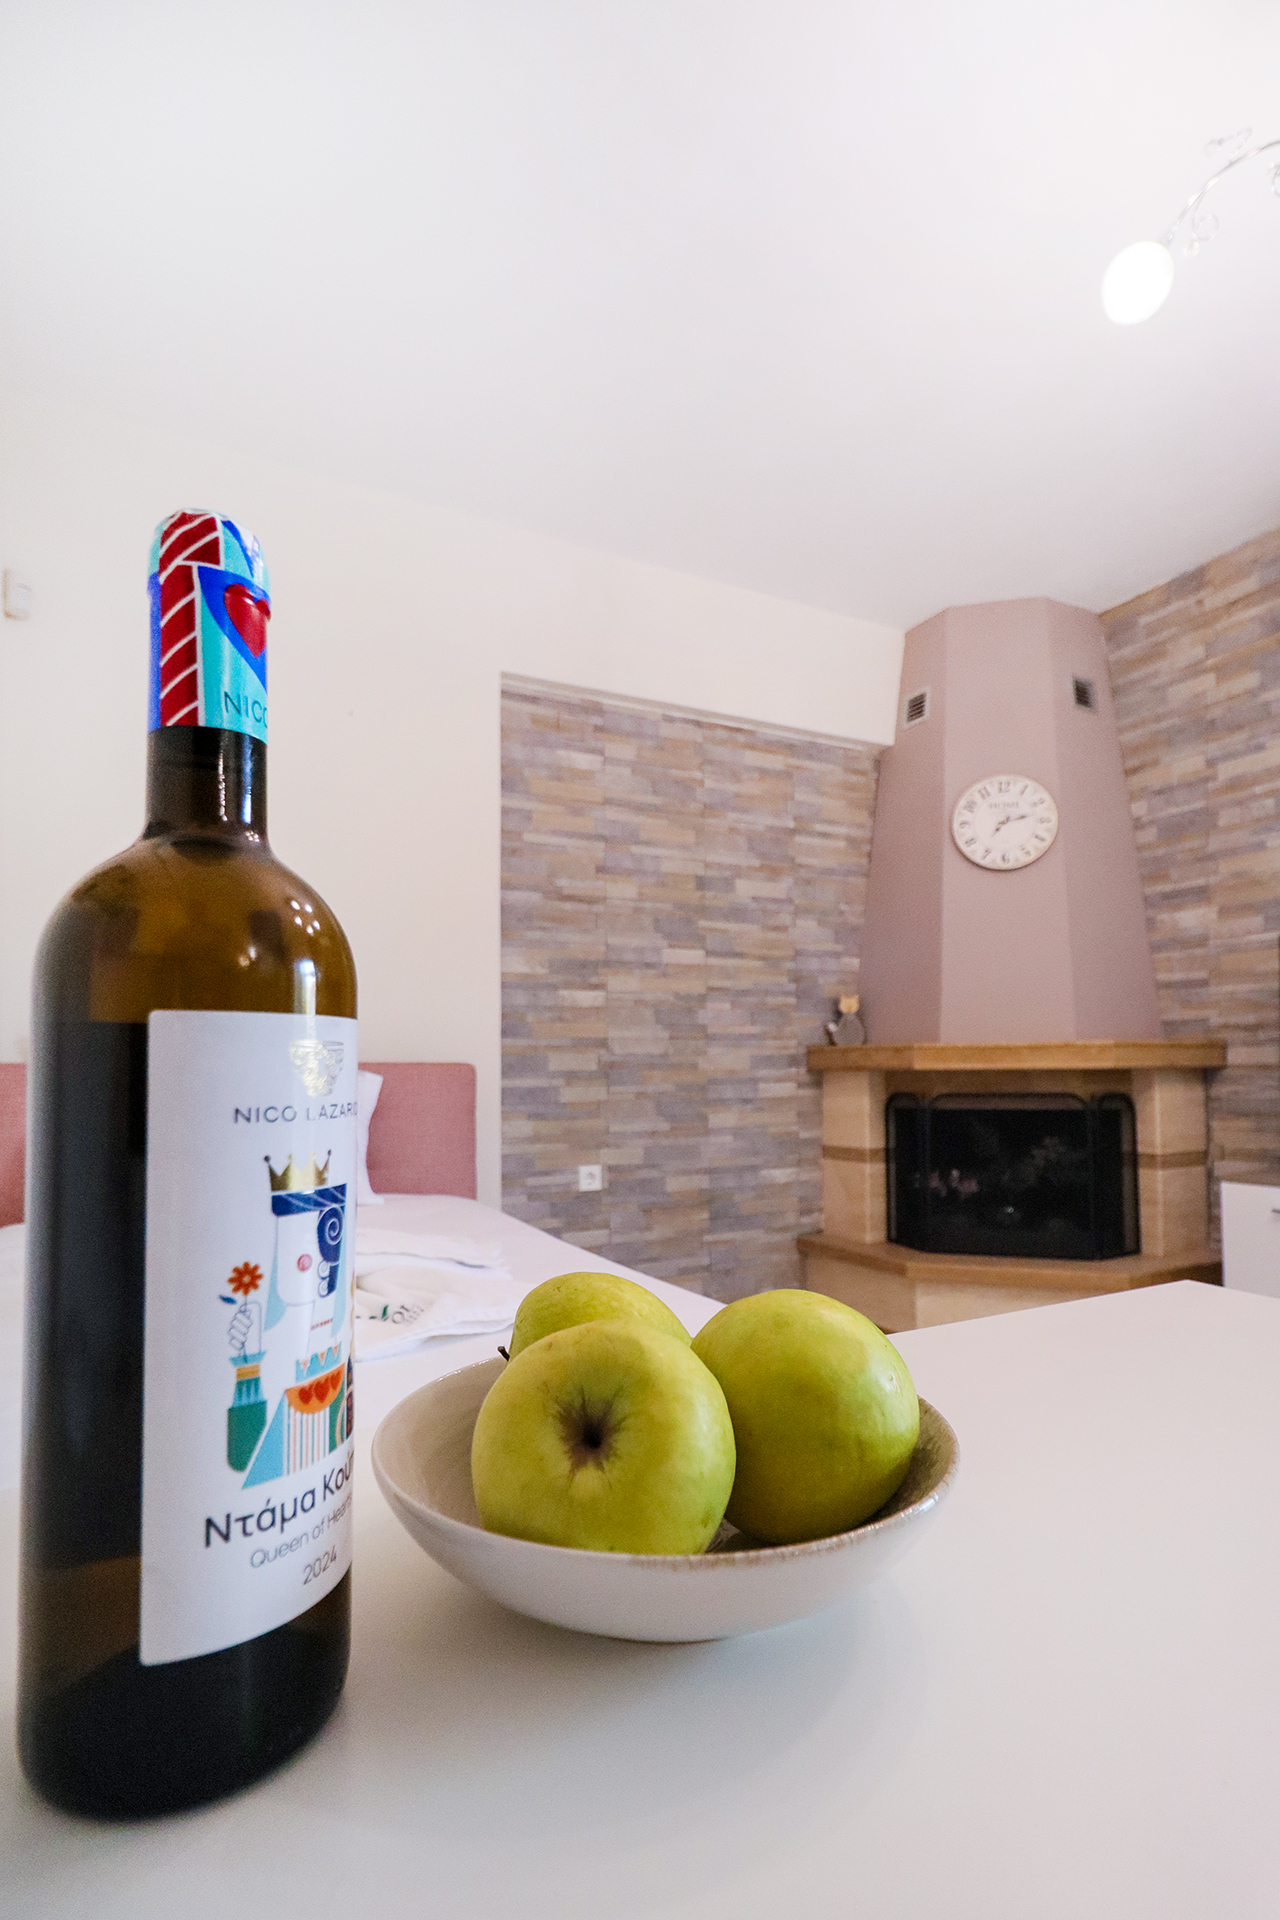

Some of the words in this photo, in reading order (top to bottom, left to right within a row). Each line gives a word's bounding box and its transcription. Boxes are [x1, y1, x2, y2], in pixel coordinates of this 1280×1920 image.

[998, 781, 1011, 794] 12
[233, 1105, 298, 1124] NICO
[204, 1487, 316, 1548] Ντάμα
[249, 1531, 310, 1569] Queen
[312, 1517, 325, 1540] of
[302, 1545, 337, 1586] 2024
